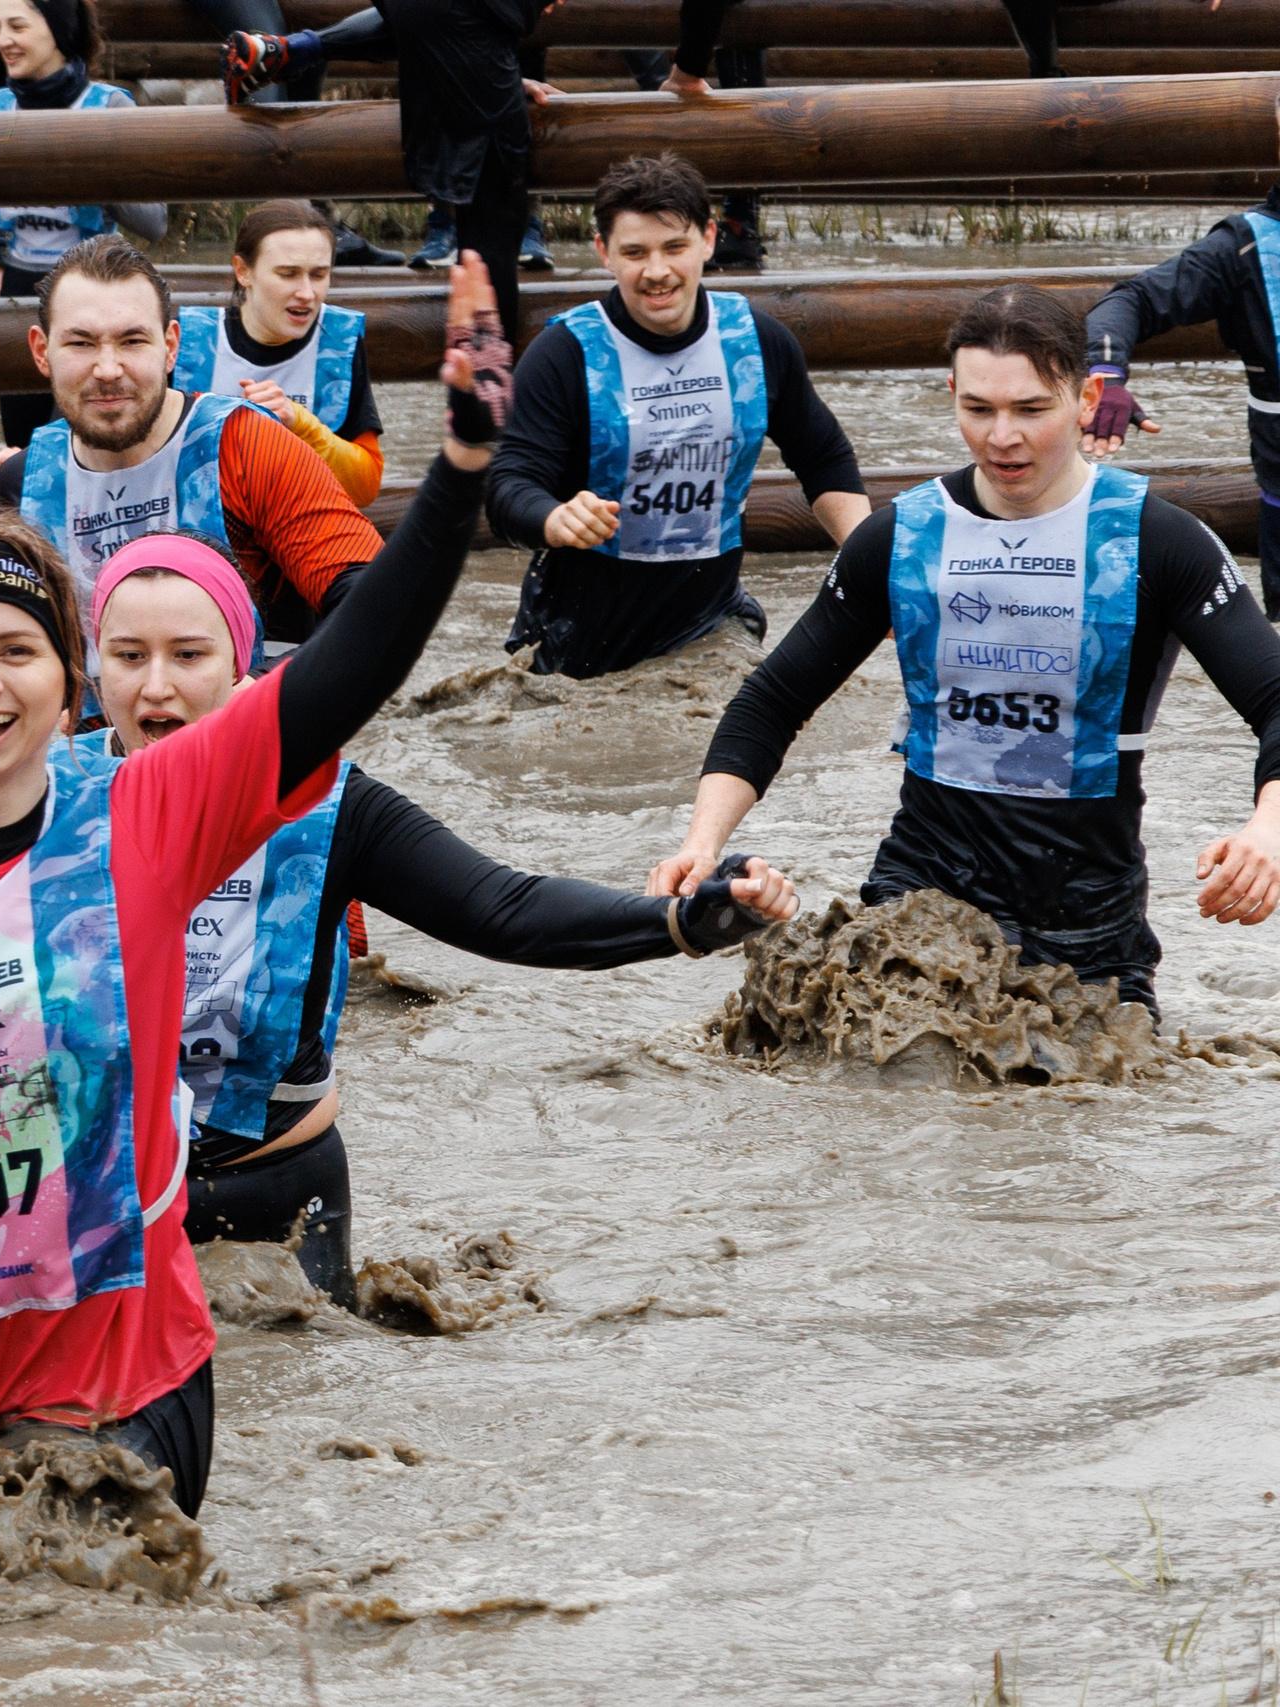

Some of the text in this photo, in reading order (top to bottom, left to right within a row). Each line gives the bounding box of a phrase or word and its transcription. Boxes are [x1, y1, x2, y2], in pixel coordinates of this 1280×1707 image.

[631, 376, 722, 397] ГОНКА ГЕРОЕВ
[648, 402, 712, 422] Sminex
[630, 480, 716, 516] 5404
[115, 497, 169, 520] ГЕРОЕВ
[91, 535, 130, 562] Smi
[949, 556, 1076, 572] ГОНКА ГЕРОЕВ
[999, 604, 1074, 618] НОВИКОМ
[214, 879, 252, 895] ОЕВ
